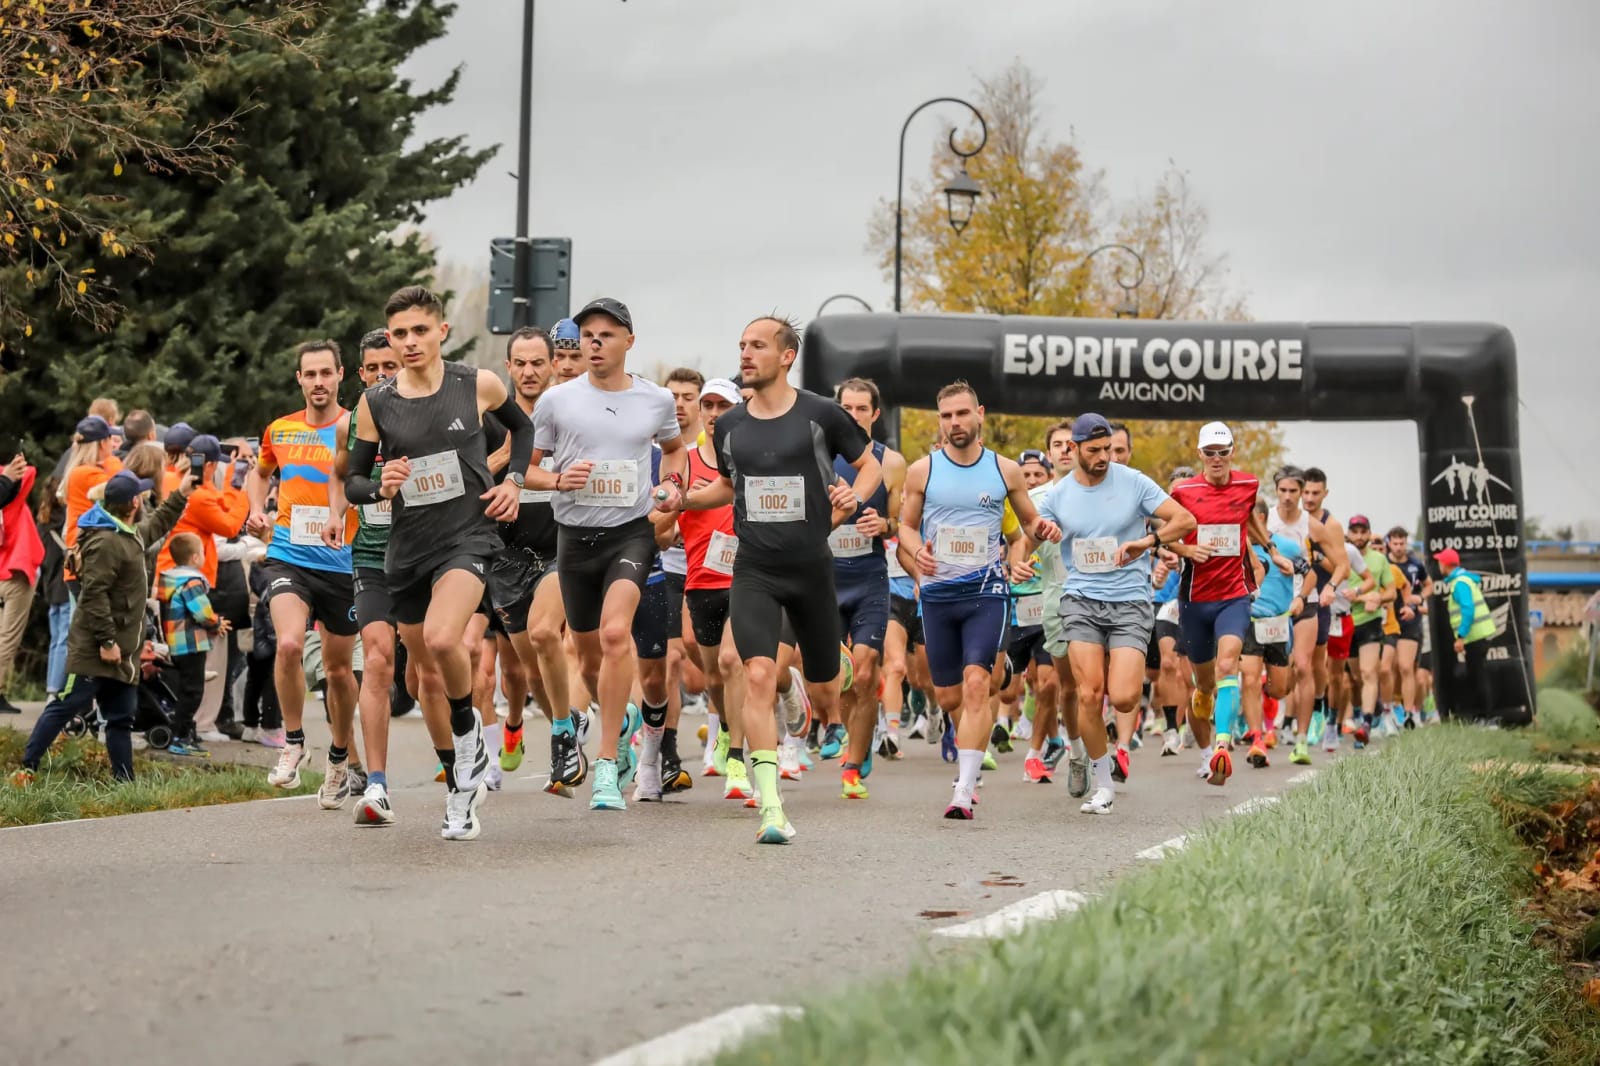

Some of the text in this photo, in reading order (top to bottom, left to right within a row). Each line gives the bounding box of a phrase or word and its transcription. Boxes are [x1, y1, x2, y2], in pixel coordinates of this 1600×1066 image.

[1003, 334, 1303, 381] ESPRIT COURSE
[1099, 381, 1205, 402] AVIGNON
[413, 472, 445, 493] 1019
[591, 478, 622, 495] 1016
[759, 494, 788, 510] 1002
[1428, 504, 1517, 523] ESPRIT COURSE
[304, 521, 326, 535] 100
[838, 537, 861, 549] 1018
[950, 541, 975, 554] 1009
[1445, 537, 1462, 550] 90
[1465, 536, 1483, 549] 39
[1486, 535, 1503, 549] 52
[1505, 535, 1519, 548] 87
[1084, 552, 1107, 564] 1374
